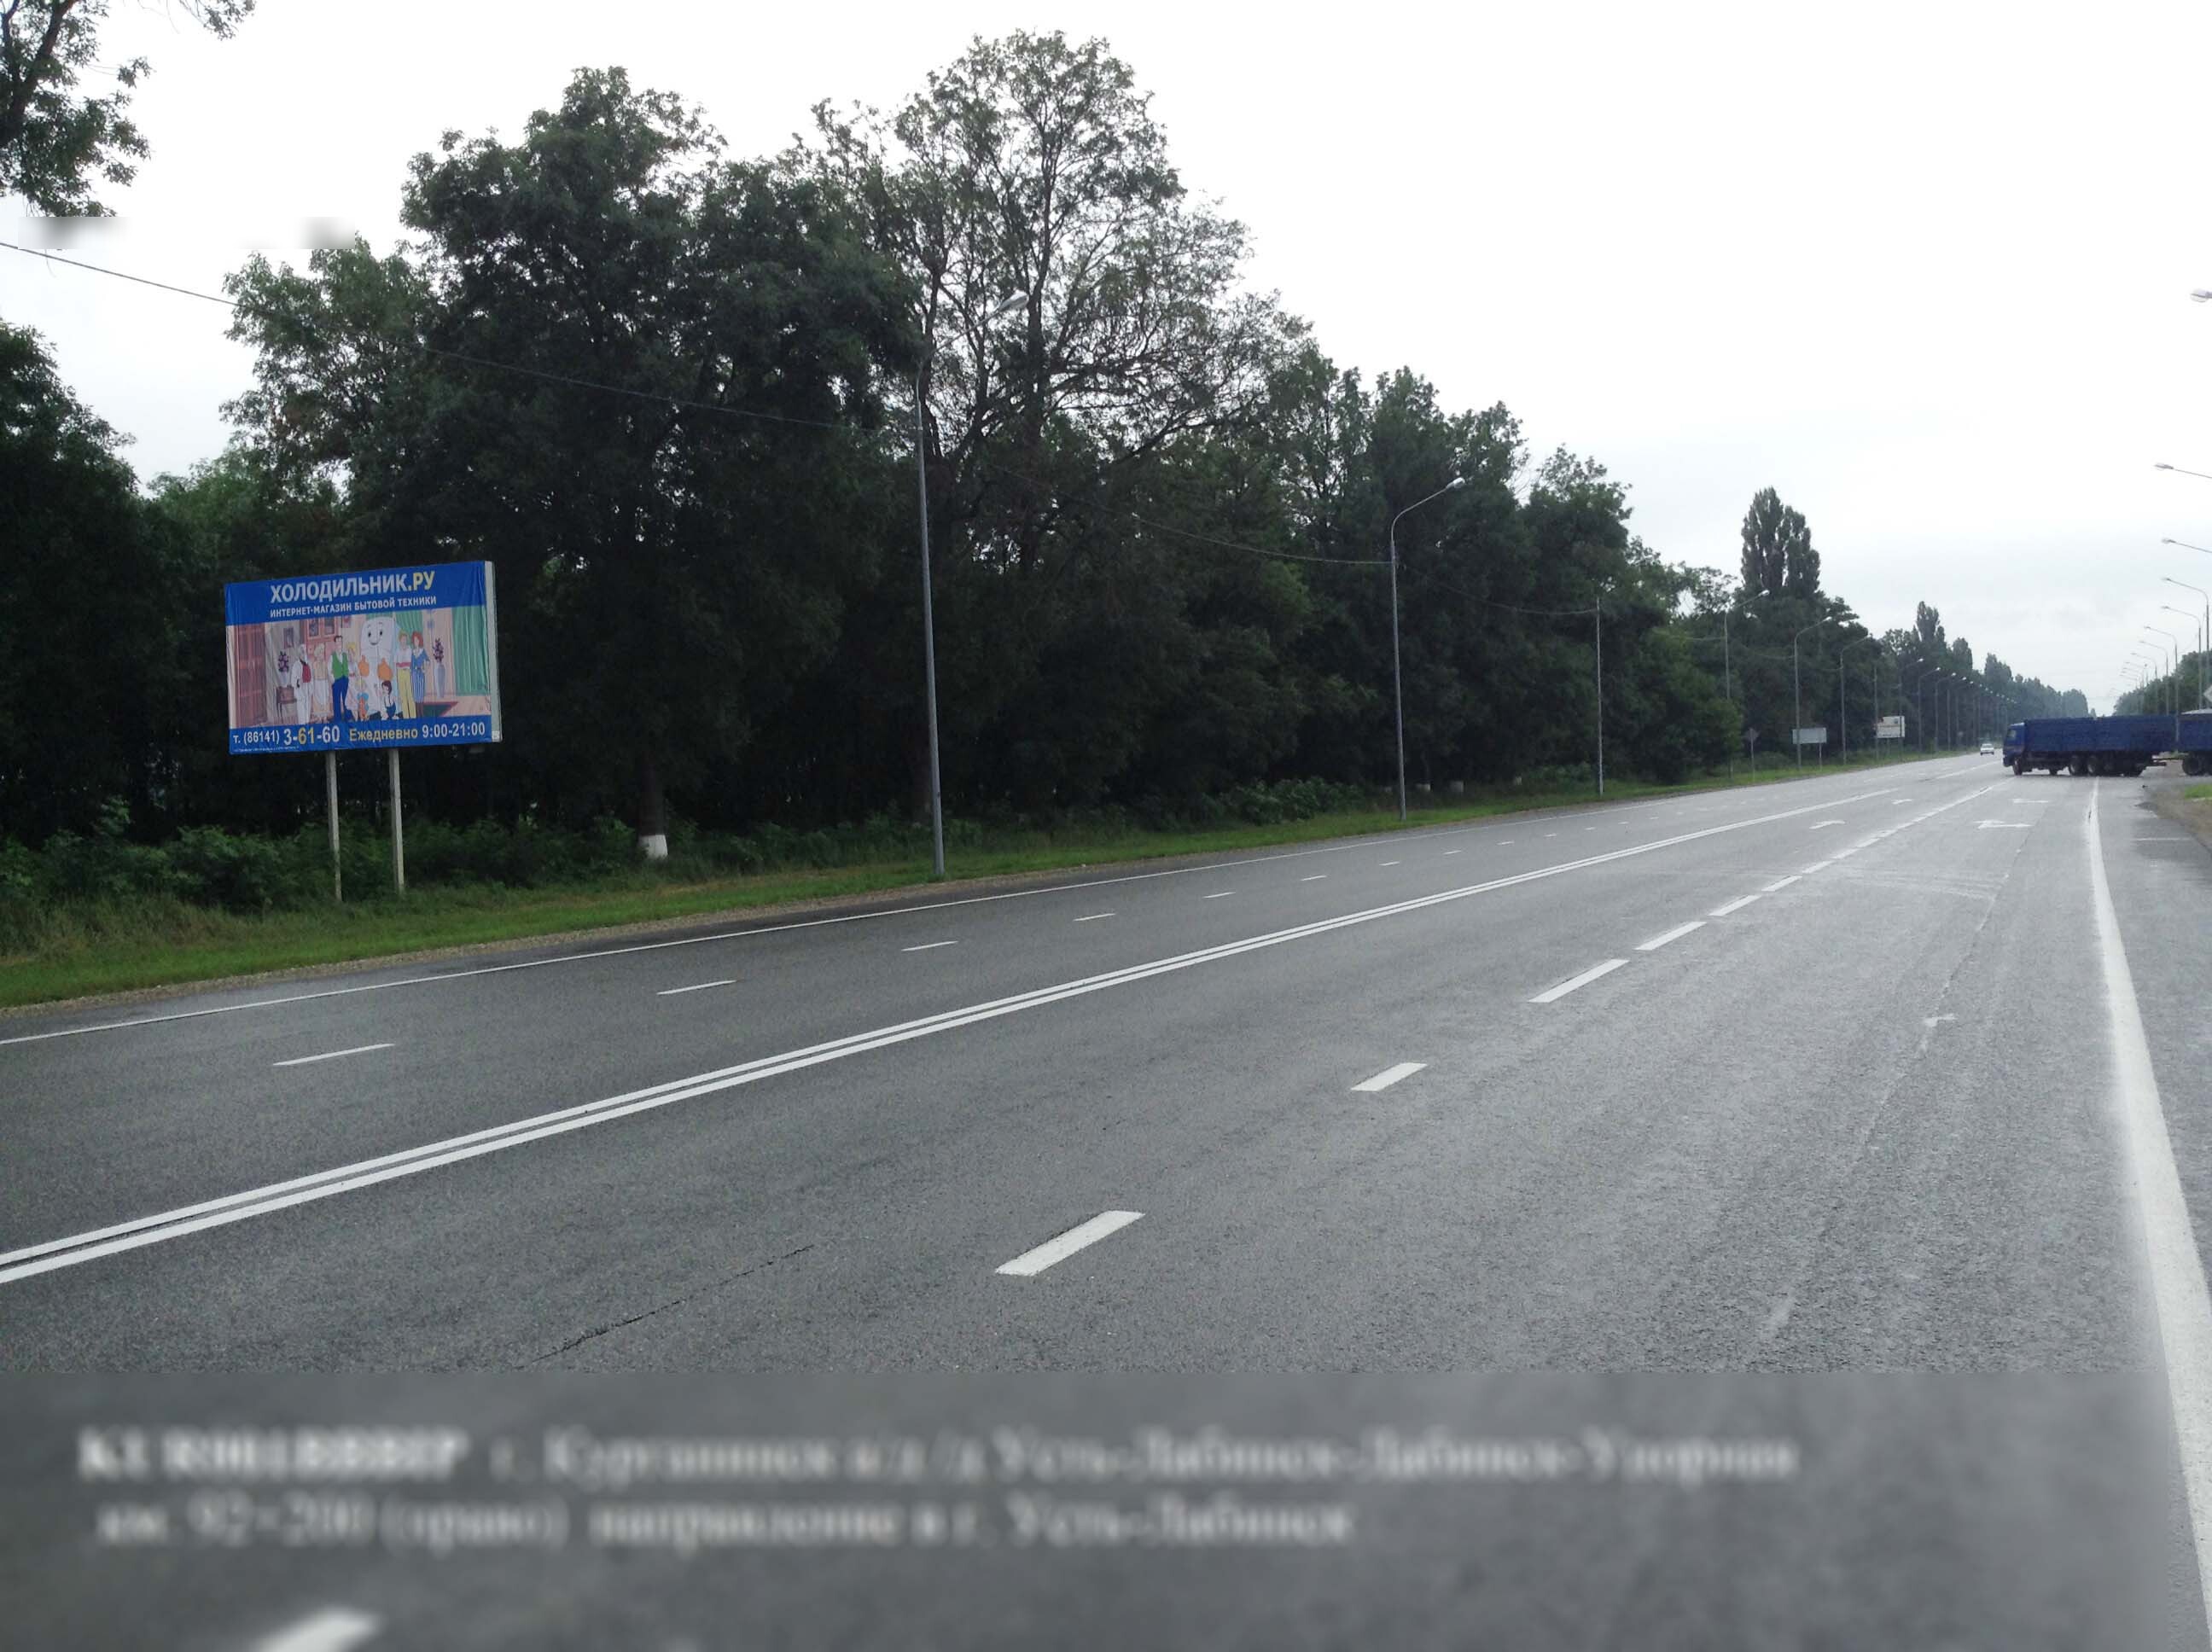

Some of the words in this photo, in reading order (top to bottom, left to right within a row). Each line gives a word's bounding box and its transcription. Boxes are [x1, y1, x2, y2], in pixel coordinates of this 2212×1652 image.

[270, 570, 435, 604] ХОЛОДИЛЬНИК.РУ
[270, 603, 352, 619] ИНТЕРНЕТ-МАГАЗИН
[354, 597, 396, 612] БЫТОВОЙ
[398, 596, 437, 608] ТЕХНИКИ
[243, 730, 280, 745] (86141)
[283, 725, 341, 746] 3-61-60
[349, 728, 418, 742] Ежедневно
[422, 722, 486, 739] 9:00-21:00
